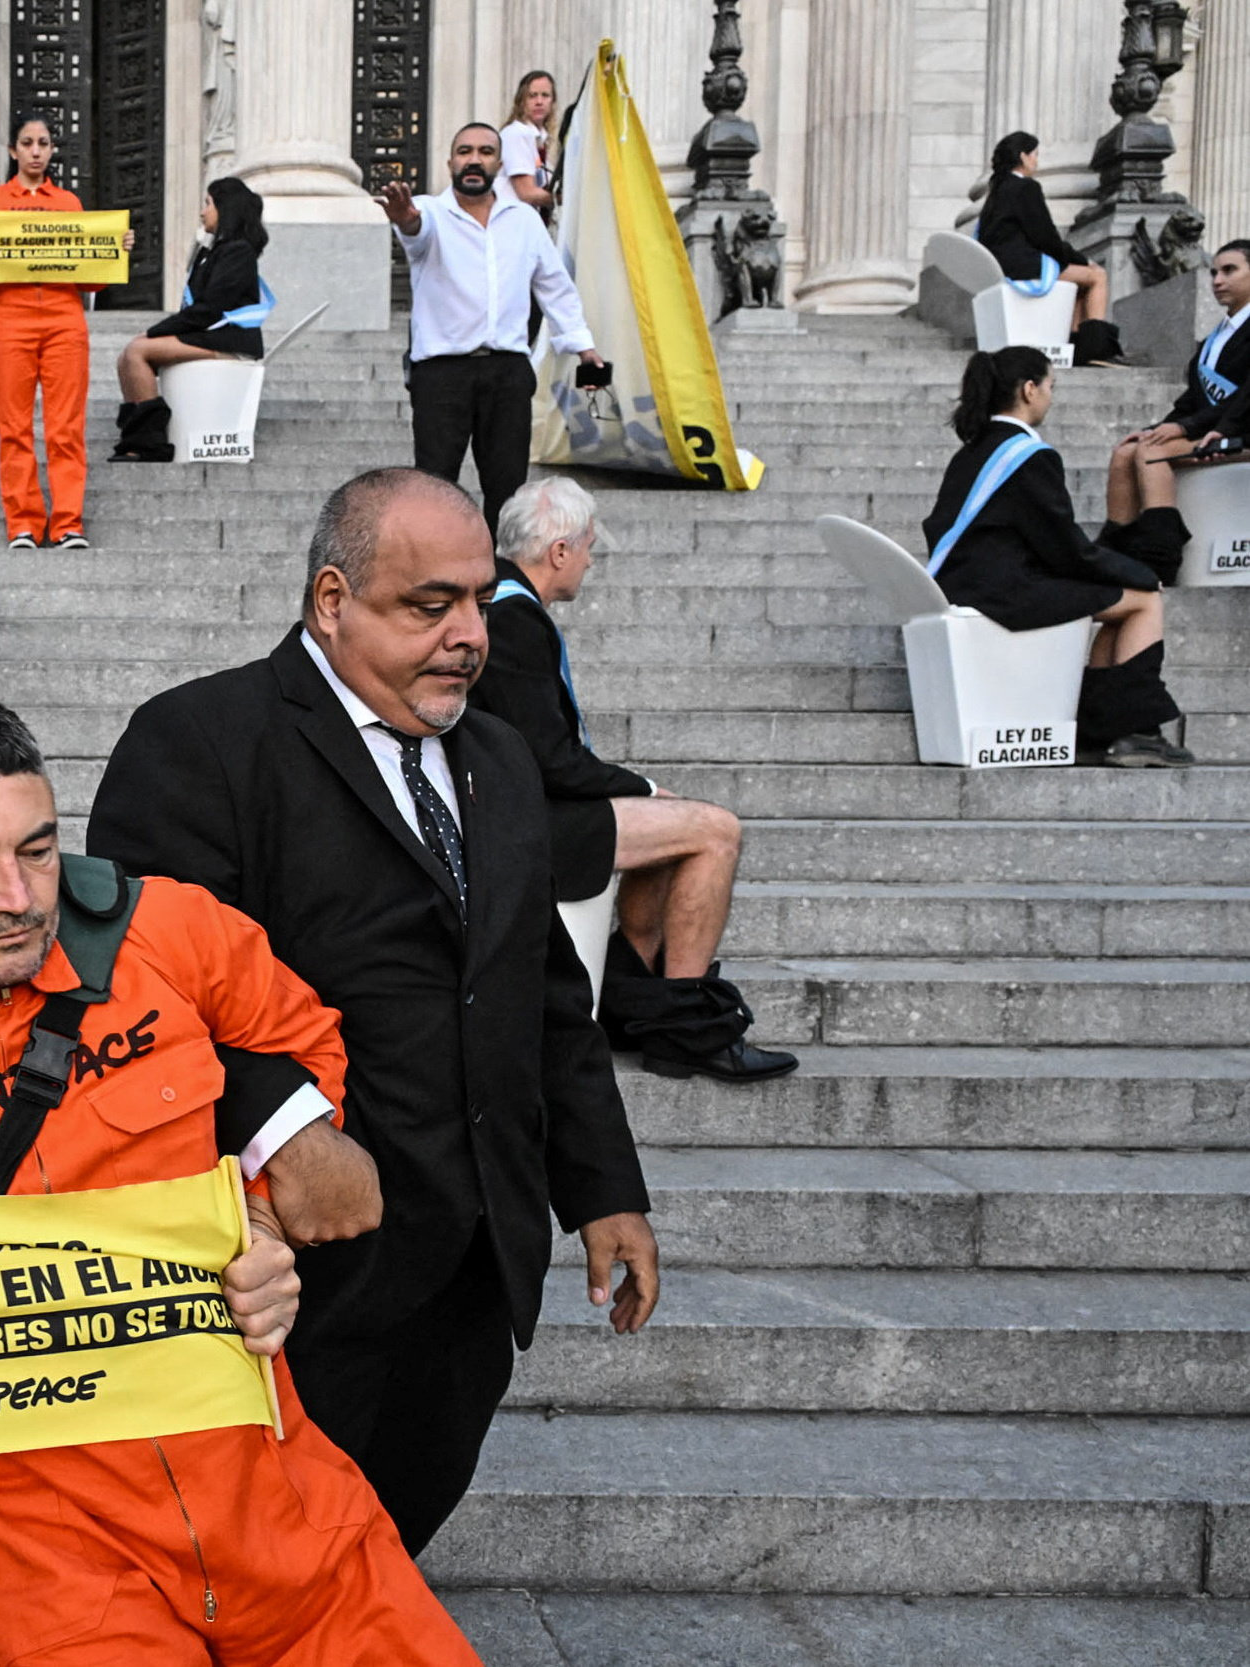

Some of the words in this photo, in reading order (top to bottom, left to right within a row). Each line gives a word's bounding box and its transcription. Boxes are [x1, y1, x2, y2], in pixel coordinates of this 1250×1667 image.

[21, 224, 84, 233] SENADORES:
[0, 237, 11, 246] SE
[15, 237, 55, 246] CAGUEN
[58, 237, 71, 246] EN
[75, 237, 85, 246] EL
[89, 236, 116, 246] AGUA
[203, 434, 221, 445] LEY
[225, 433, 238, 444] DE
[193, 446, 250, 458] GLACIARES
[996, 729, 1025, 744] LEY
[1031, 727, 1053, 742] DE
[978, 745, 1069, 764] GLACIARES
[0, 1263, 66, 1307] EN
[75, 1256, 133, 1296] EL
[64, 1312, 116, 1347] NO
[126, 1307, 167, 1338] SE
